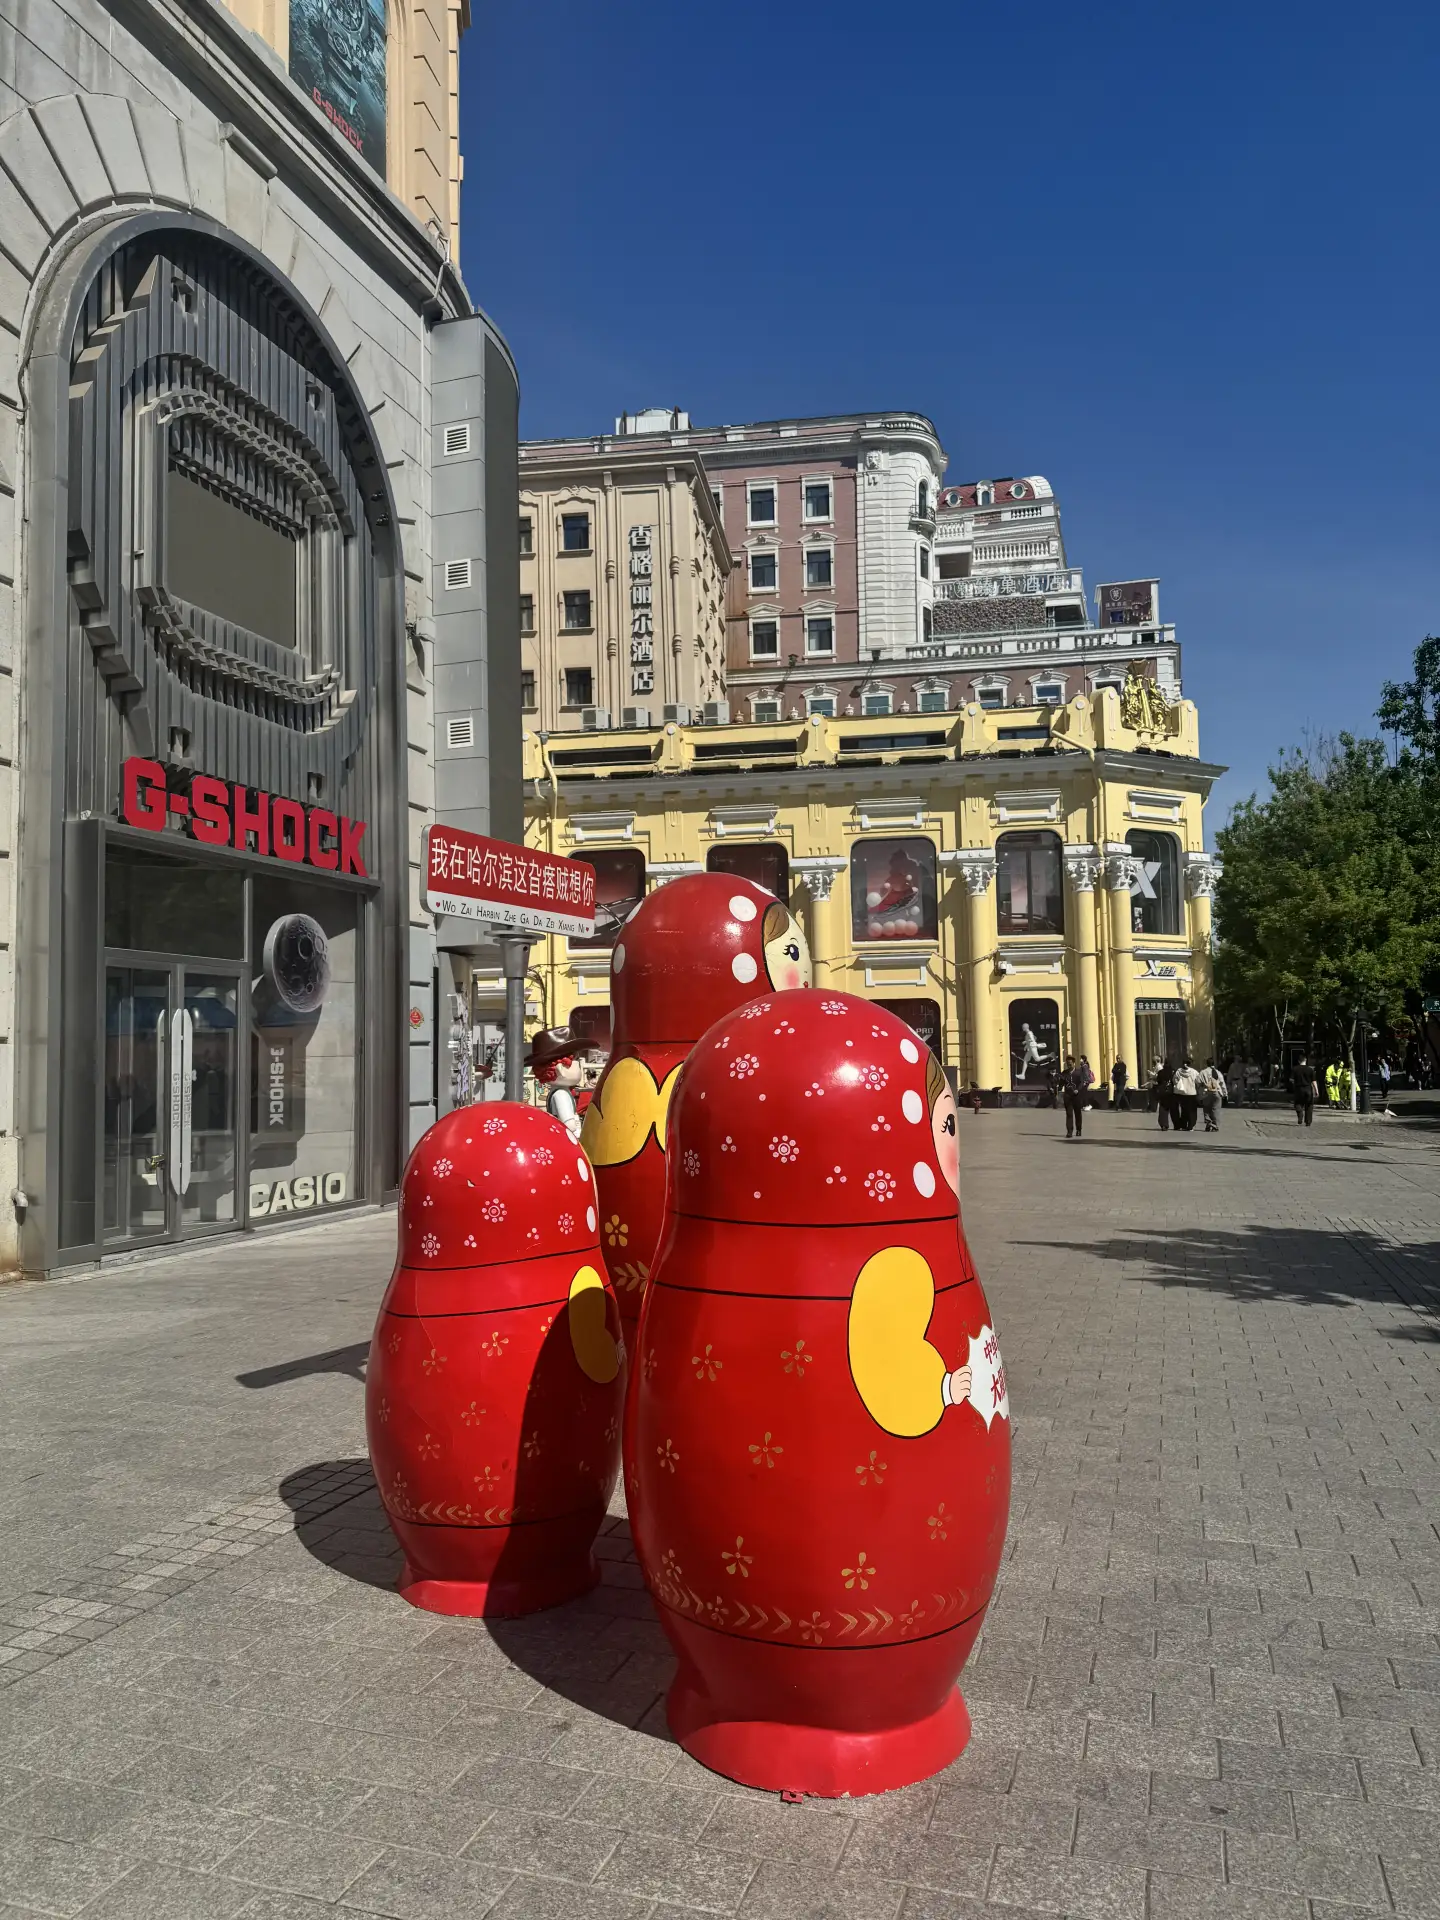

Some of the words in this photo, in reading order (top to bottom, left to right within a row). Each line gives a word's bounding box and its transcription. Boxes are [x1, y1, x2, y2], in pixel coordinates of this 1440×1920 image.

[312, 87, 363, 153] G-SHOCK
[122, 756, 369, 878] G-SHOCK
[431, 837, 595, 907] 我在哈尔滨这旮瘩贼想你
[172, 1072, 180, 1129] G-SHOCK
[249, 1172, 346, 1217] CASIO
